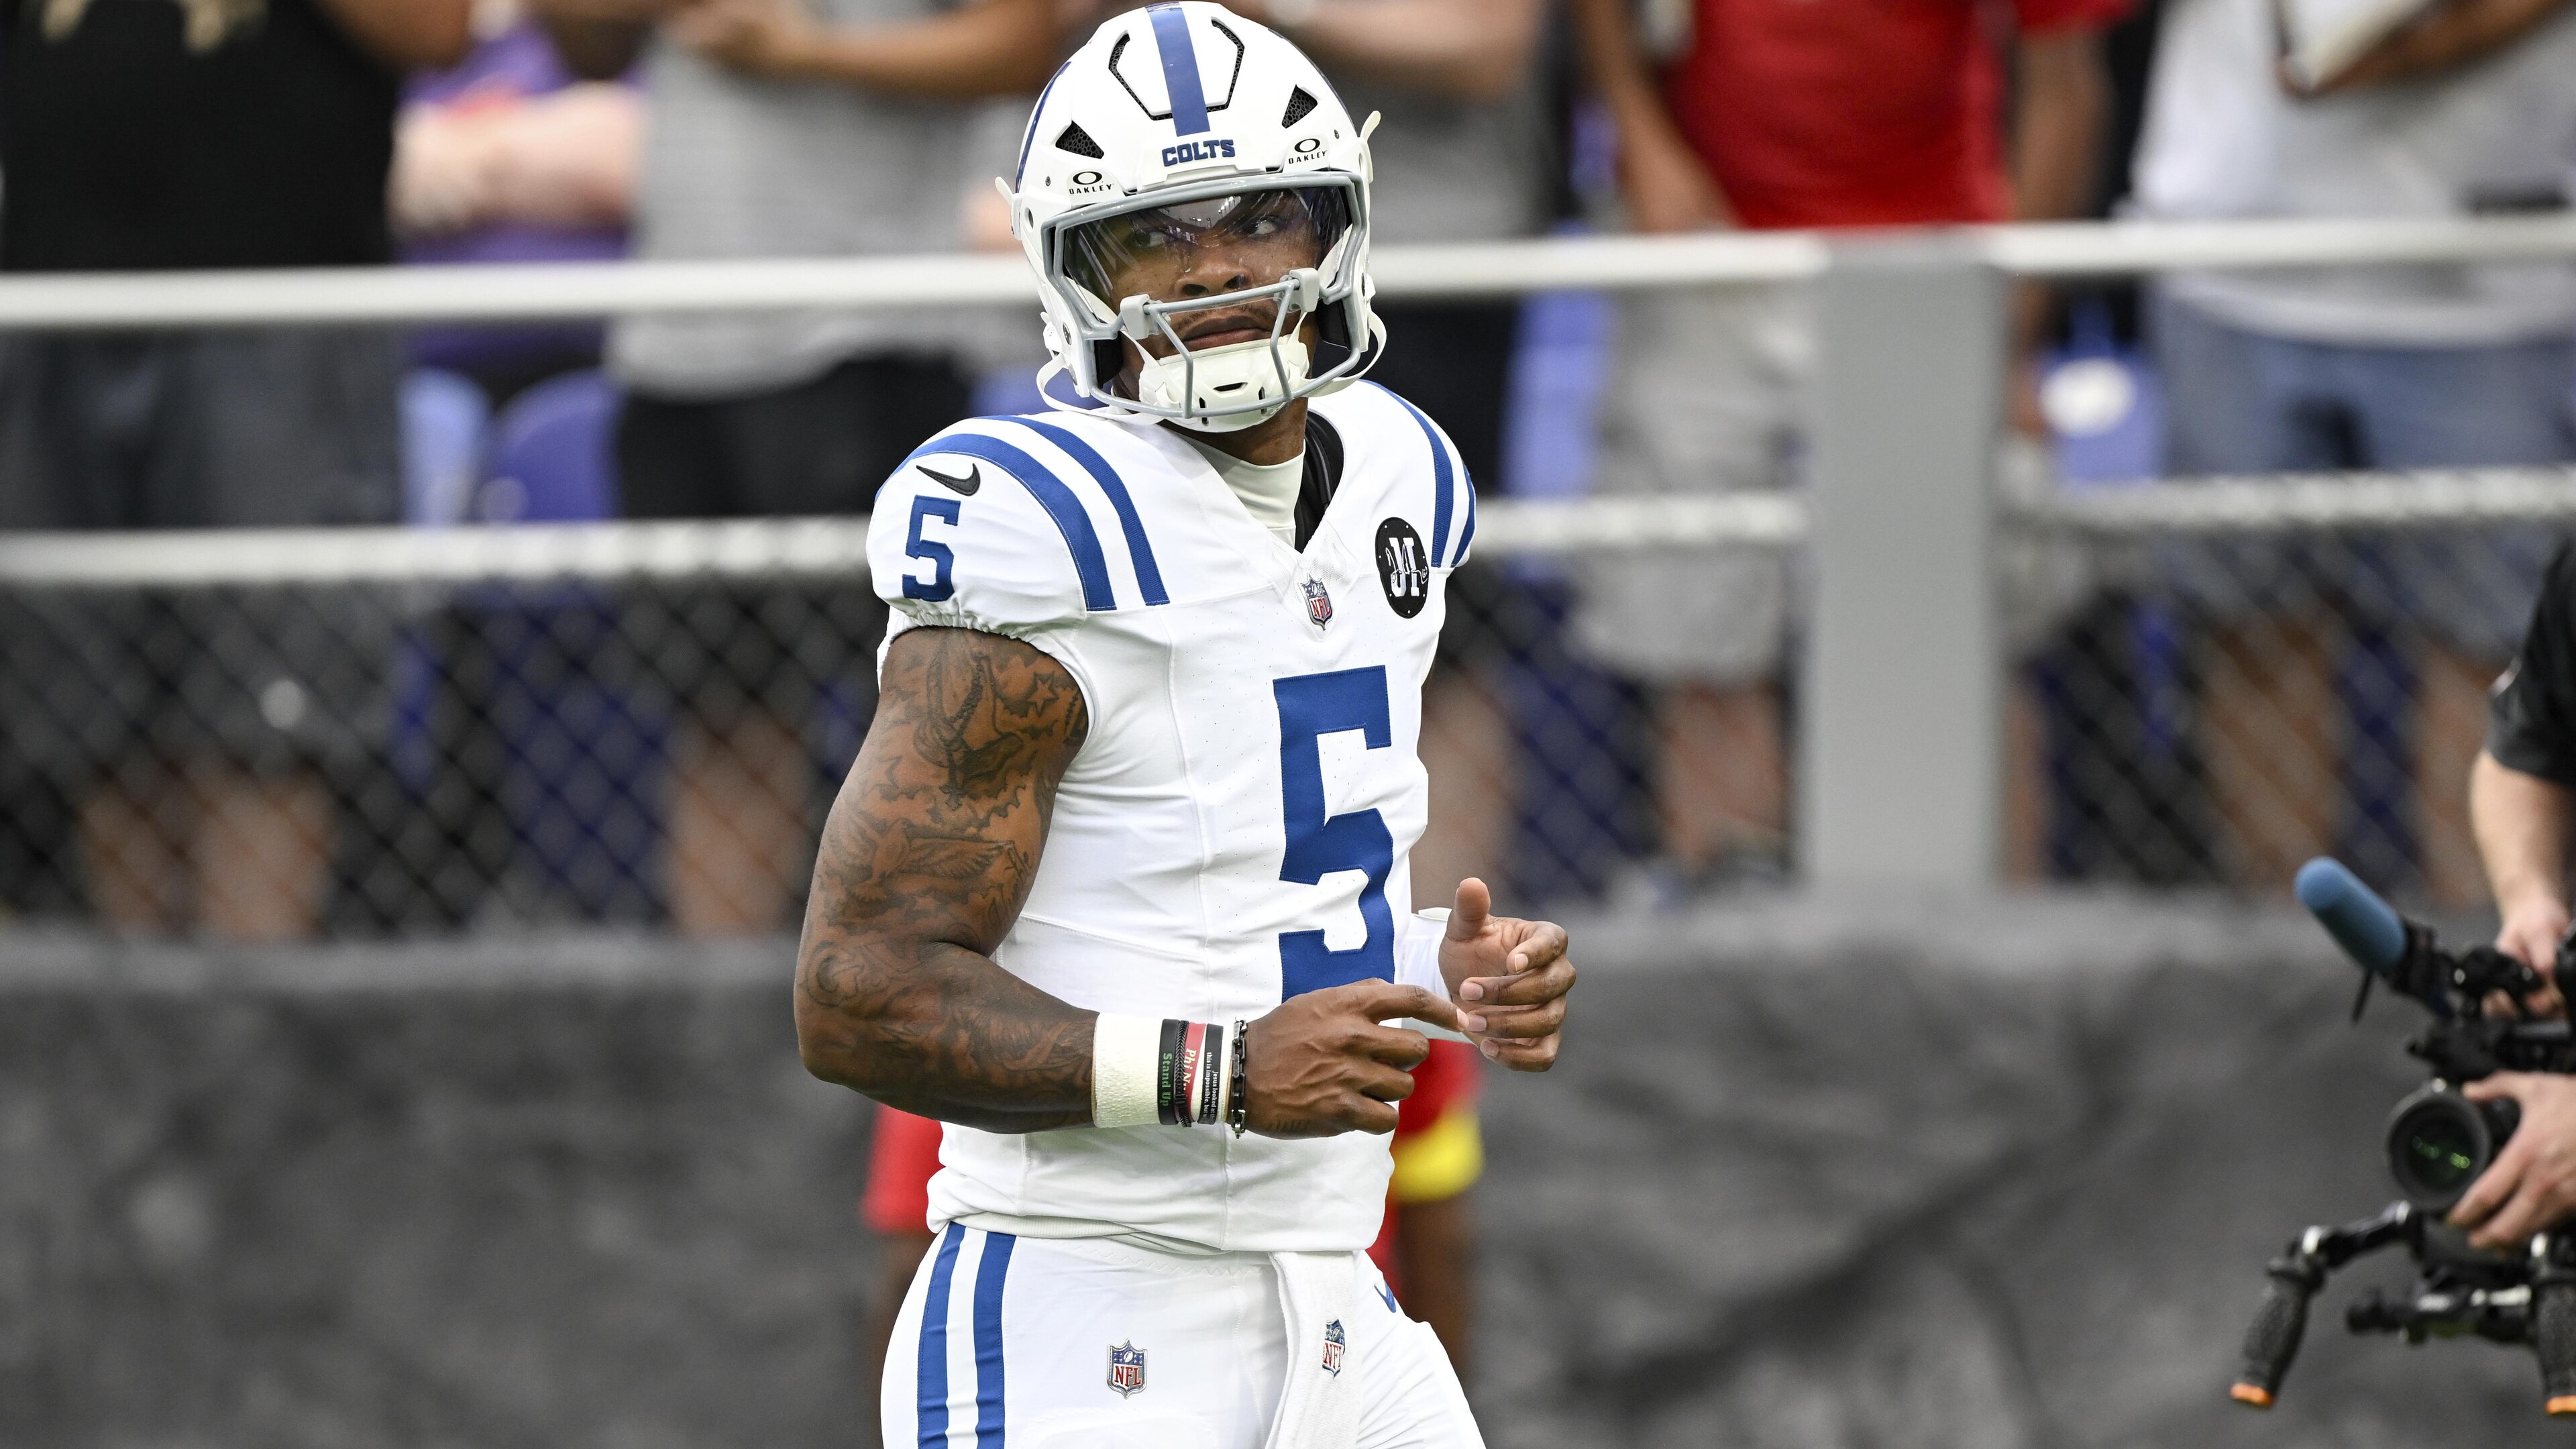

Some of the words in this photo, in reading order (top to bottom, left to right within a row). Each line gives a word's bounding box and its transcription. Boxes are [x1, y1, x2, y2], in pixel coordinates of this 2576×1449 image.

[1161, 139, 1236, 167] COLTS
[1288, 150, 1326, 164] OAKLEY
[1069, 184, 1112, 195] OAKLEY
[902, 494, 961, 602] 5
[1310, 597, 1331, 619] NFL
[1273, 664, 1395, 1004] 5
[1183, 1048, 1197, 1070] Phi
[1161, 1053, 1173, 1088] Stand
[1203, 1069, 1212, 1104] impossible,
[1160, 1092, 1171, 1106] Up
[1114, 1365, 1141, 1387] NFL
